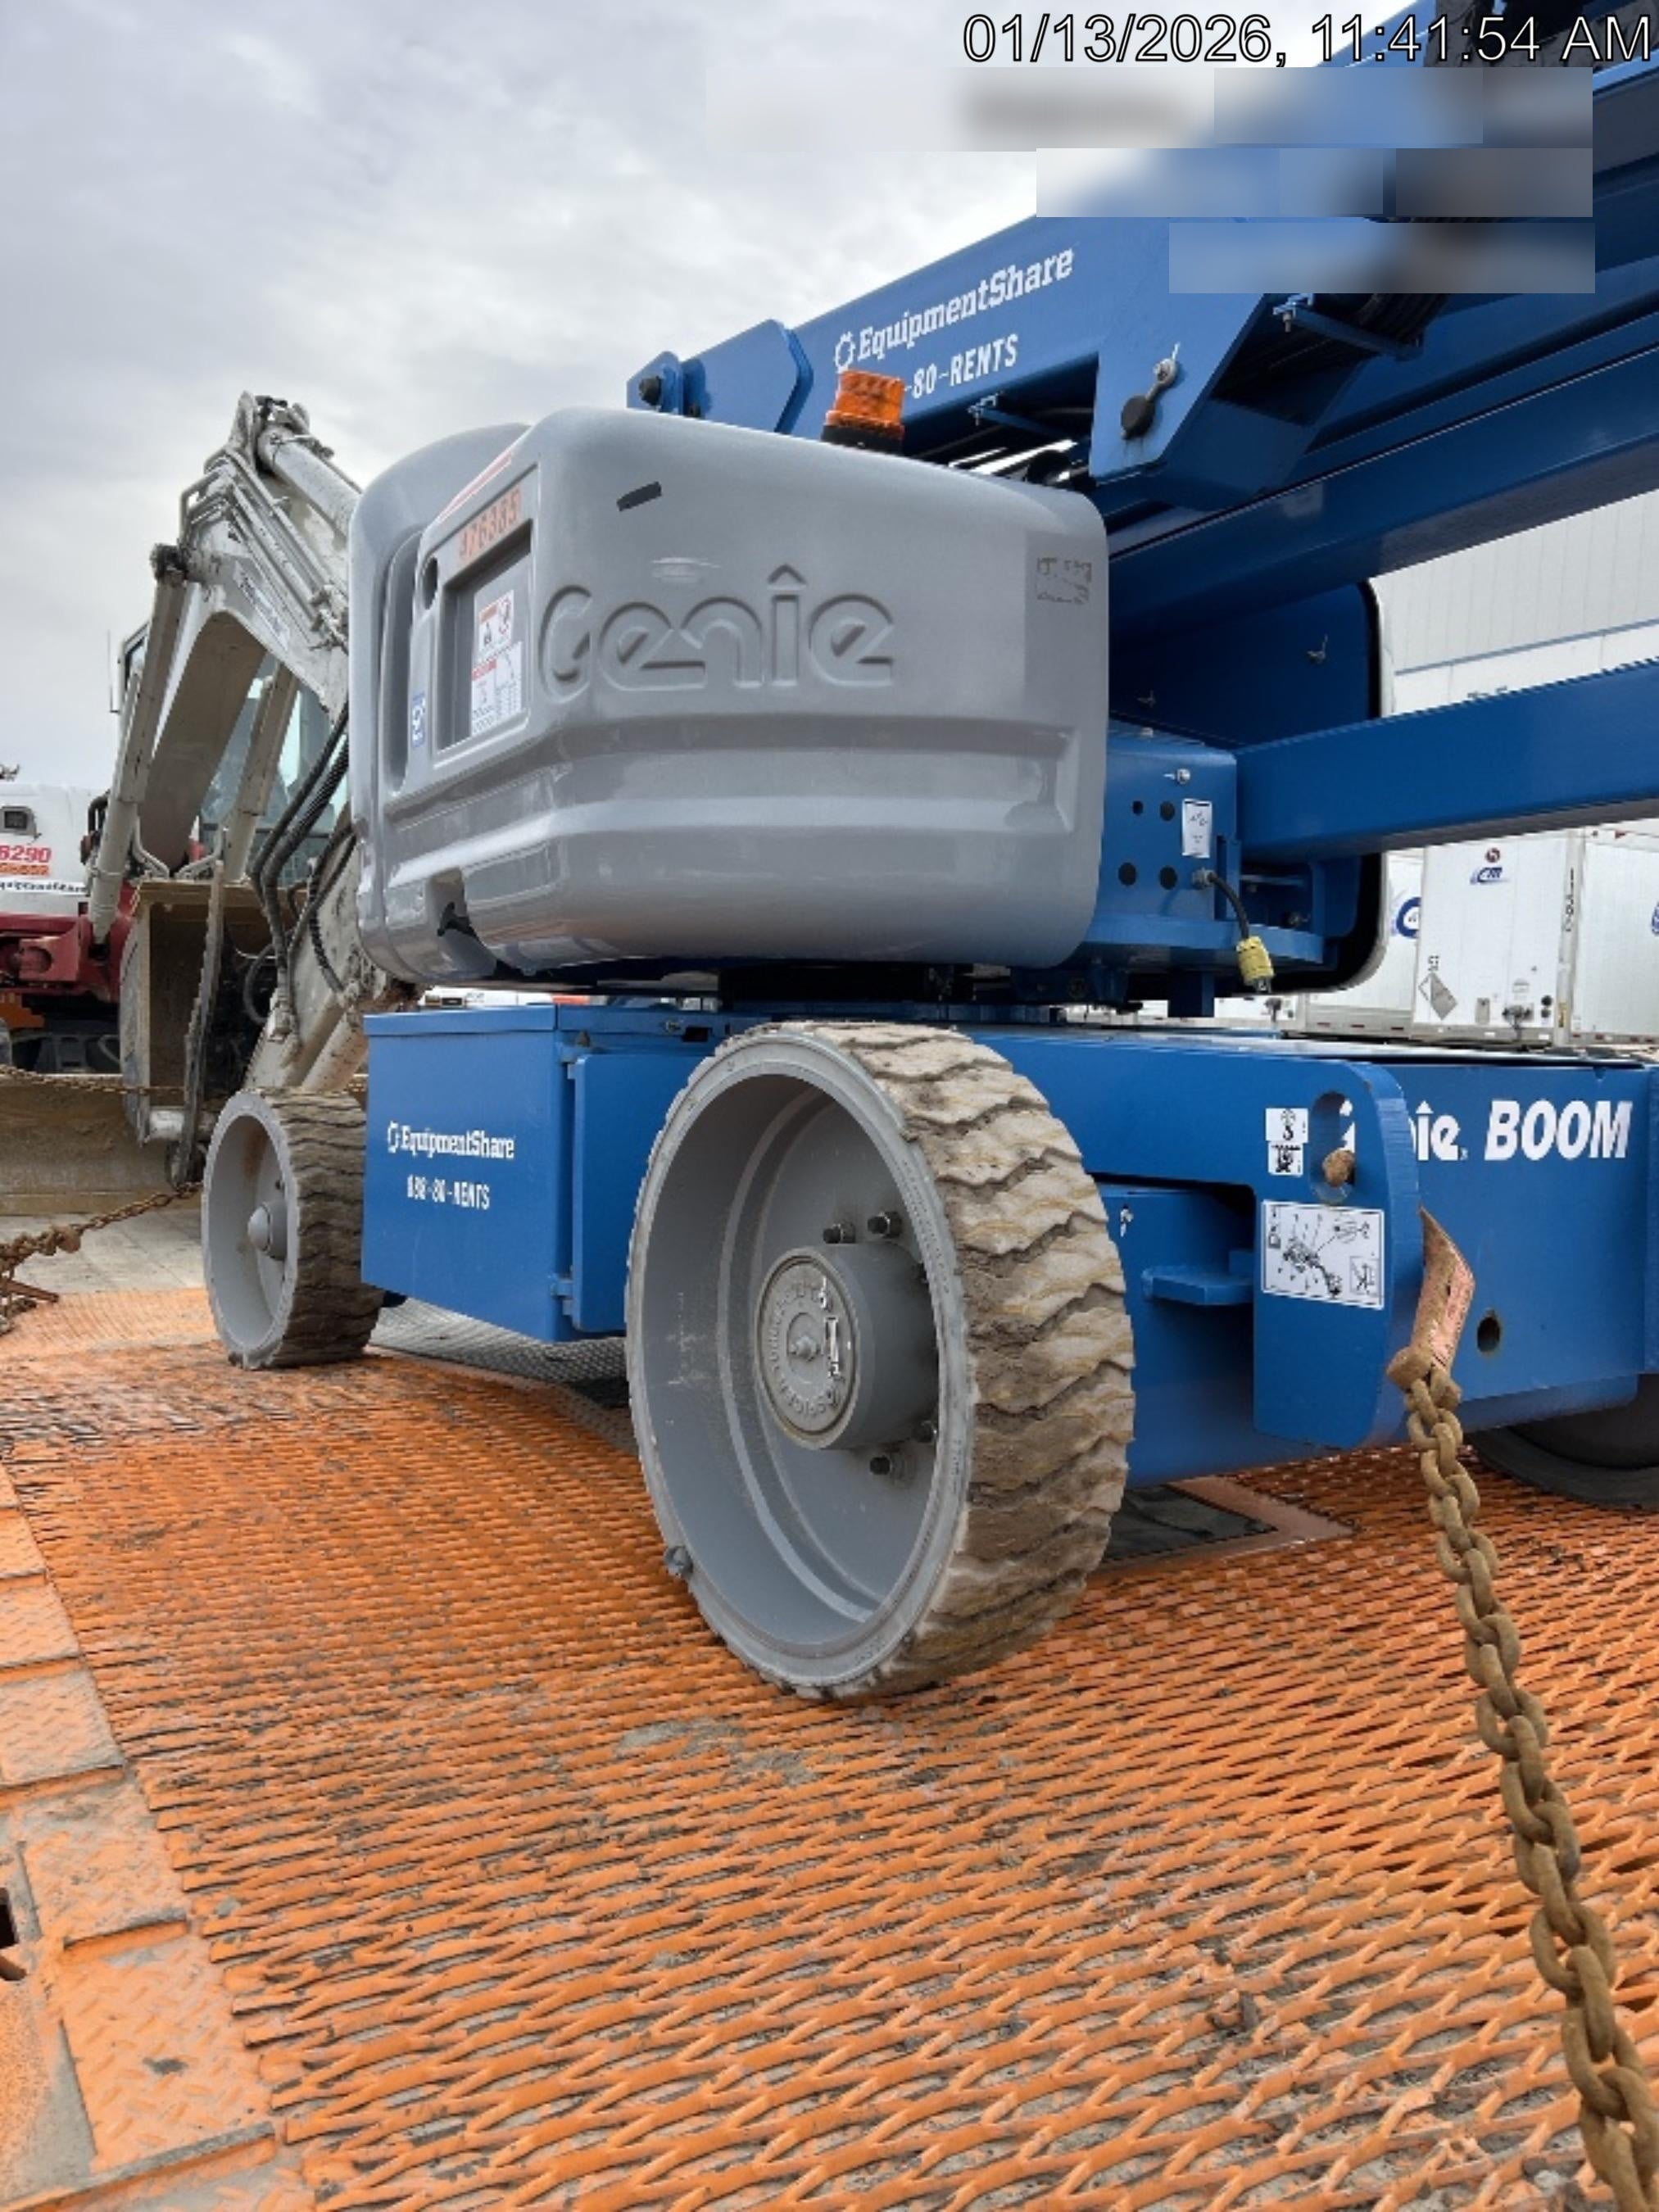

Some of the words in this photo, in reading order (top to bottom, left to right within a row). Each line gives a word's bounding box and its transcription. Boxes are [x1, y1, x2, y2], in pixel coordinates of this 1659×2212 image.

[856, 247, 1075, 362] EquipmentShare
[401, 1124, 515, 1160] EquipmentShare
[1484, 1099, 1634, 1161] BOOM
